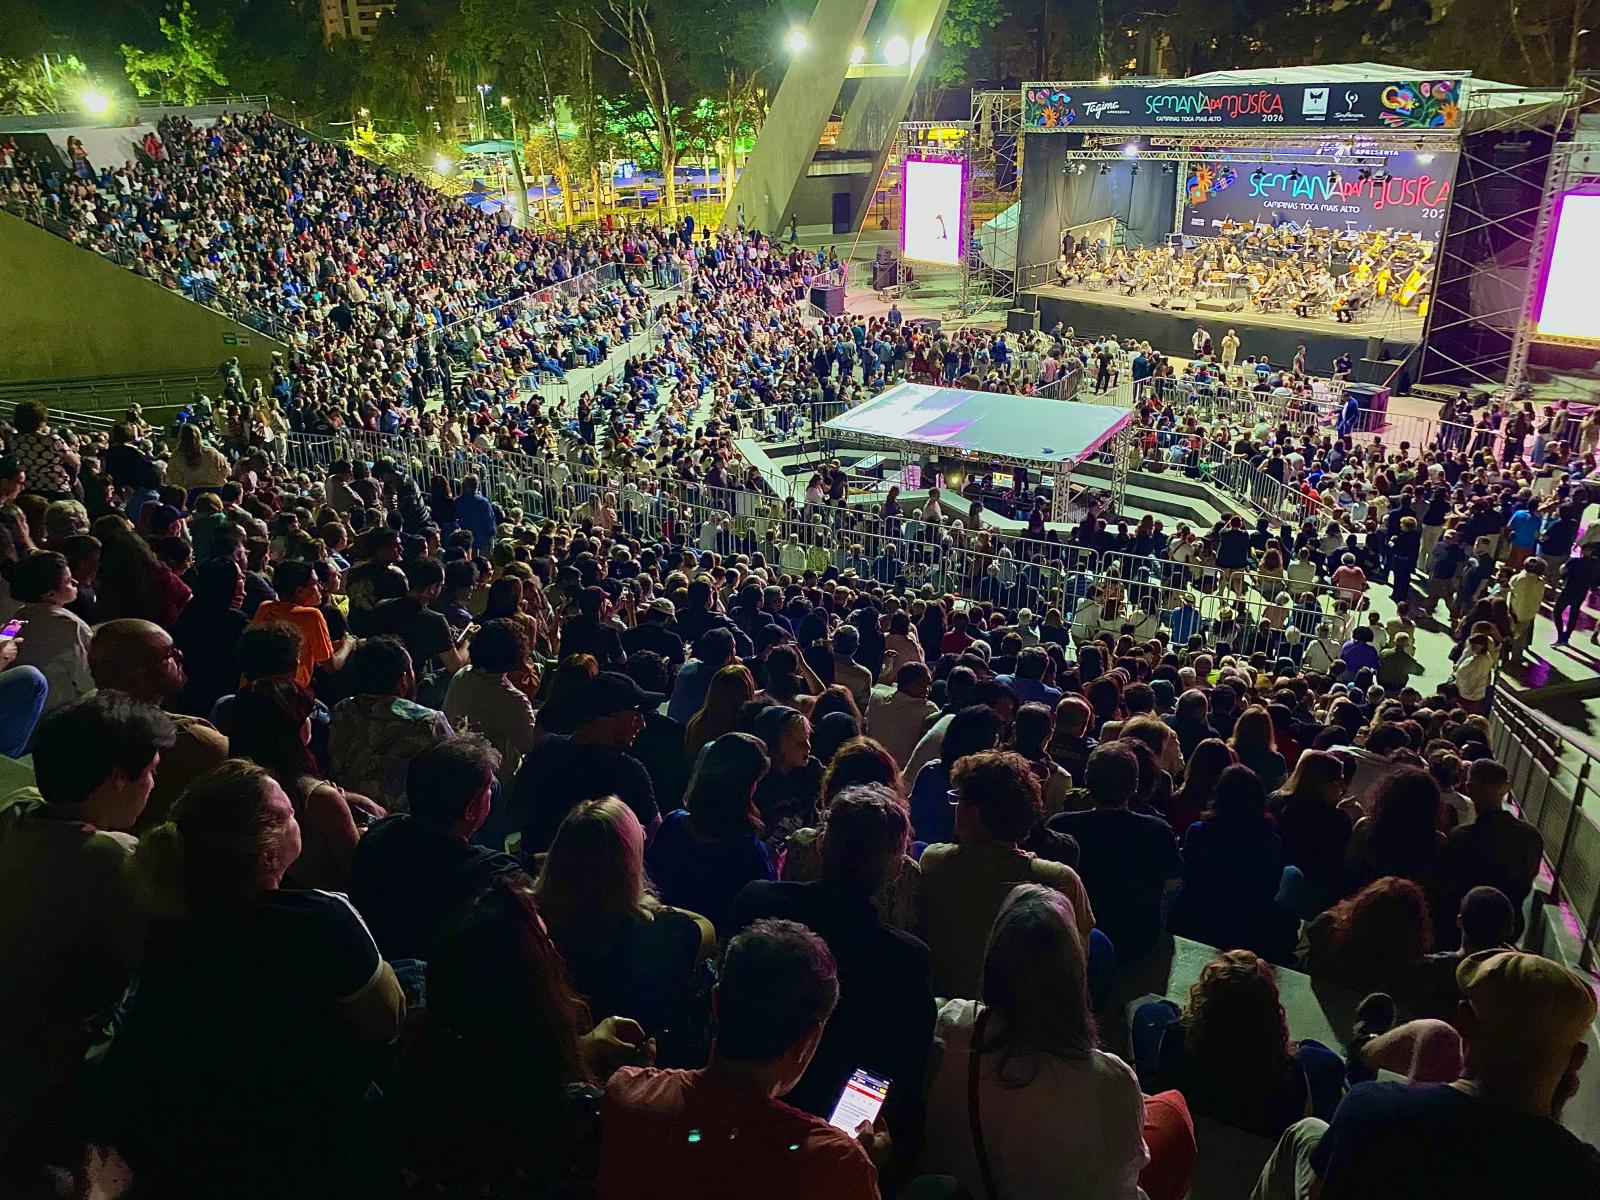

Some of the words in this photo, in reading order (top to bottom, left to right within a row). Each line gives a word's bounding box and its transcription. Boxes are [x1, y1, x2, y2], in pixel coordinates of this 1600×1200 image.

[1082, 101, 1120, 119] Tagima
[1211, 98, 1221, 110] DA
[1262, 114, 1284, 122] 2026
[1263, 200, 1298, 210] CAMPINAS
[1300, 202, 1319, 211] TOCA
[1320, 204, 1339, 212] MAIS
[1340, 205, 1360, 213] ALTO
